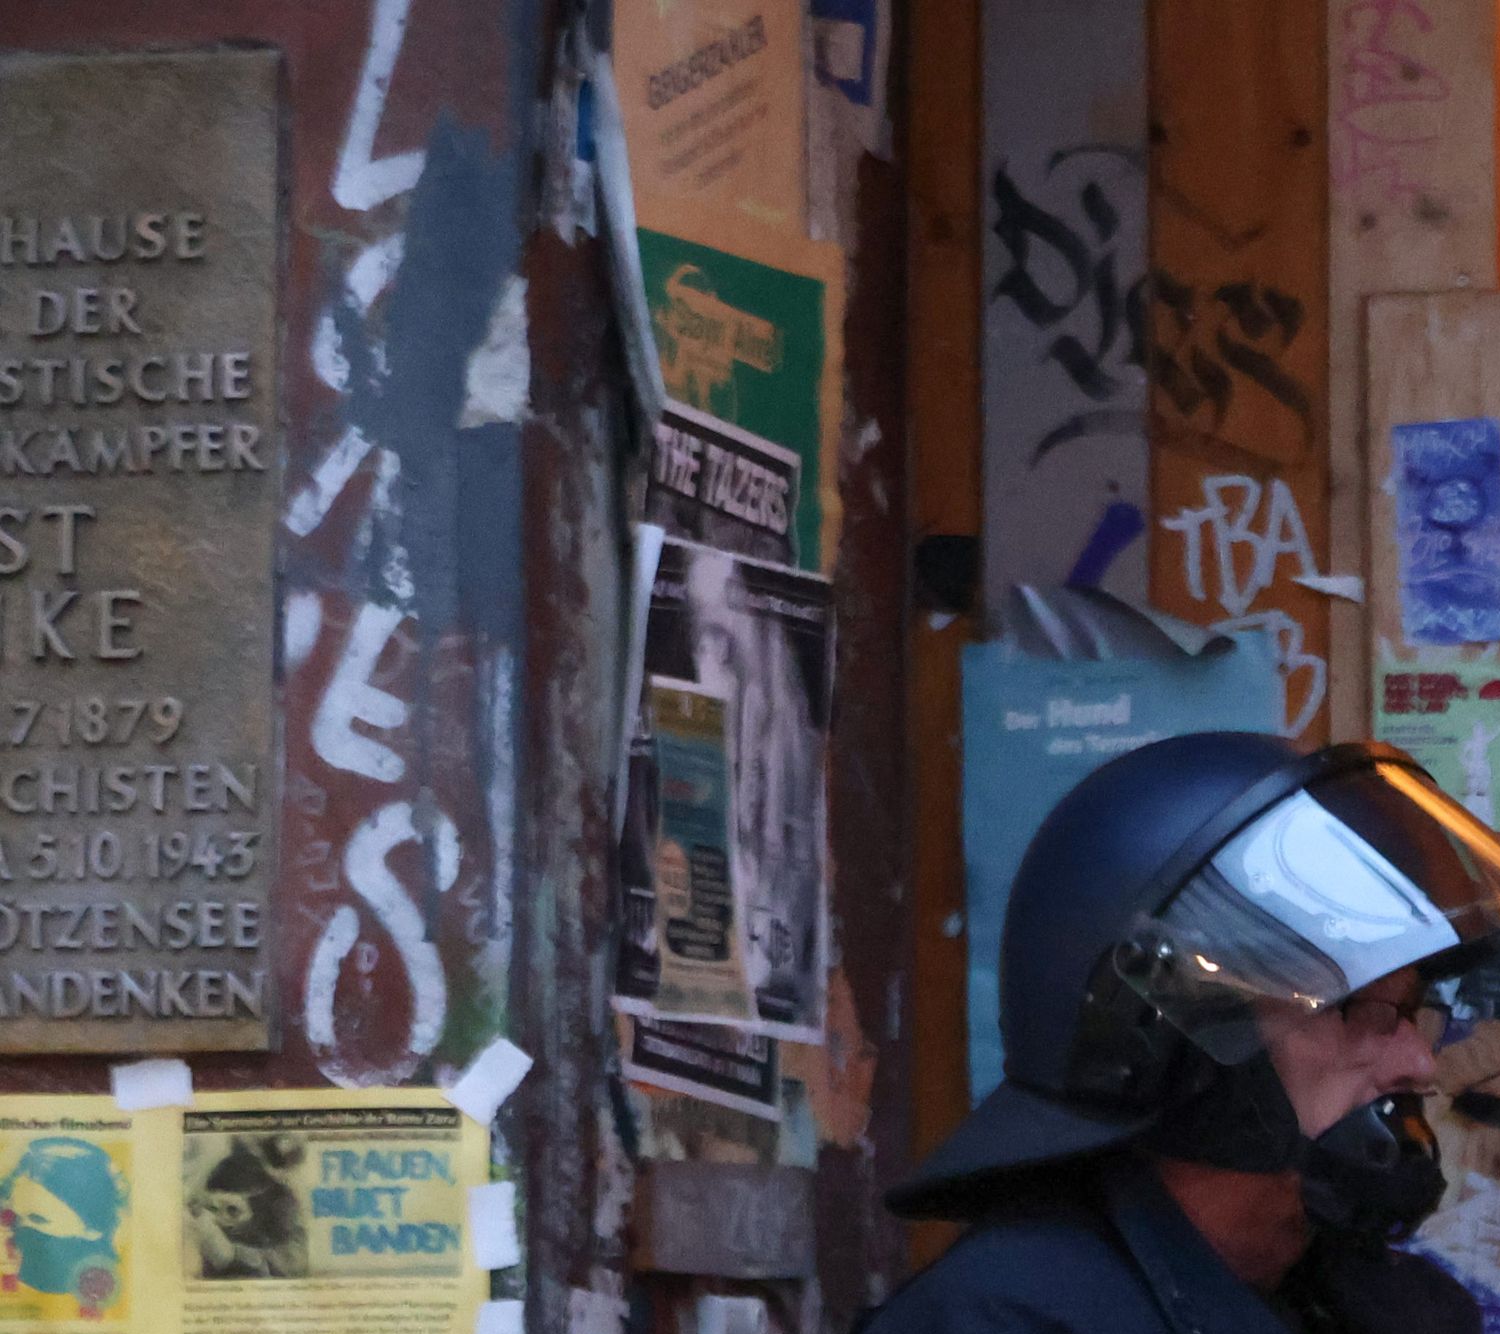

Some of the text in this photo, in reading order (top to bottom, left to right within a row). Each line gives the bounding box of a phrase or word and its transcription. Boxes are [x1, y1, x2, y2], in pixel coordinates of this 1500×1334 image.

[0, 212, 204, 265] HAUSE
[30, 288, 142, 337] DER
[0, 350, 251, 405] STISCHE
[0, 588, 144, 661] KE
[1, 763, 259, 816] CHISTEN
[0, 966, 269, 1018] NDENKEN
[331, 1222, 460, 1256] BANDEN
